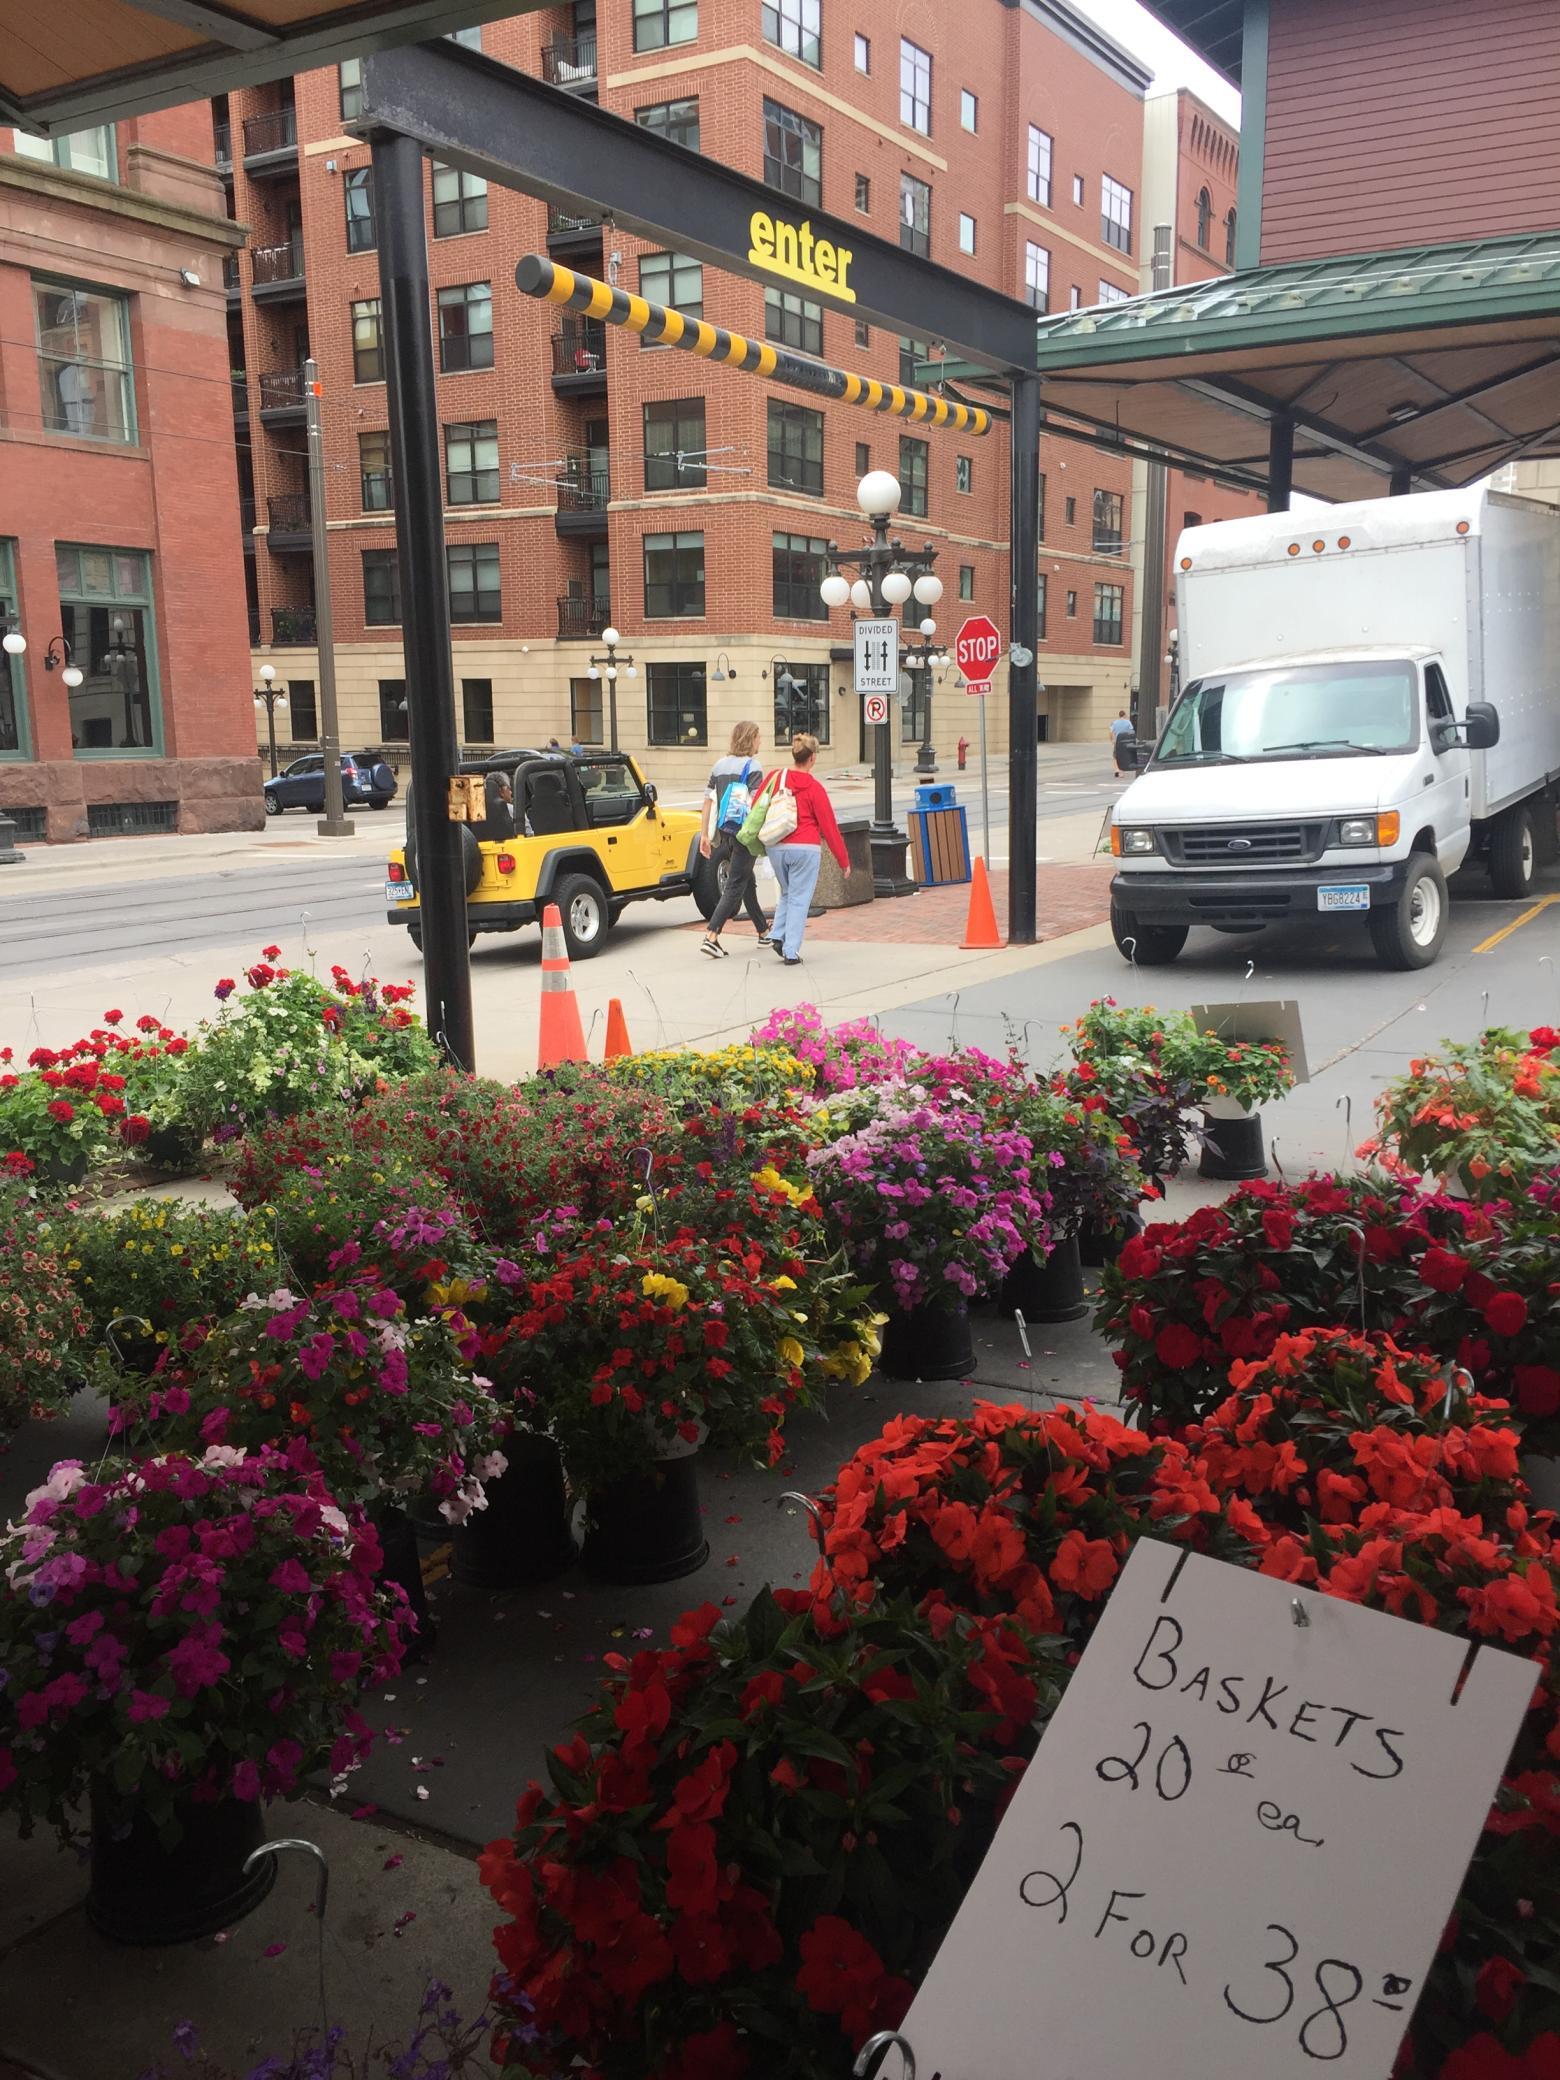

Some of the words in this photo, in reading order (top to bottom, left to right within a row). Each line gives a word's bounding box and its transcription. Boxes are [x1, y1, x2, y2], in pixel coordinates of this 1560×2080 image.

[750, 211, 853, 290] enter
[859, 625, 893, 635] DIVIDED
[958, 636, 997, 663] STOP
[860, 677, 892, 687] STREET
[1133, 1616, 1404, 1779] BASKETS
[1096, 1722, 1191, 1801] 20
[1020, 1822, 1083, 1924] 2
[1095, 1890, 1187, 1984] FOR
[1224, 1924, 1363, 2060] 38
